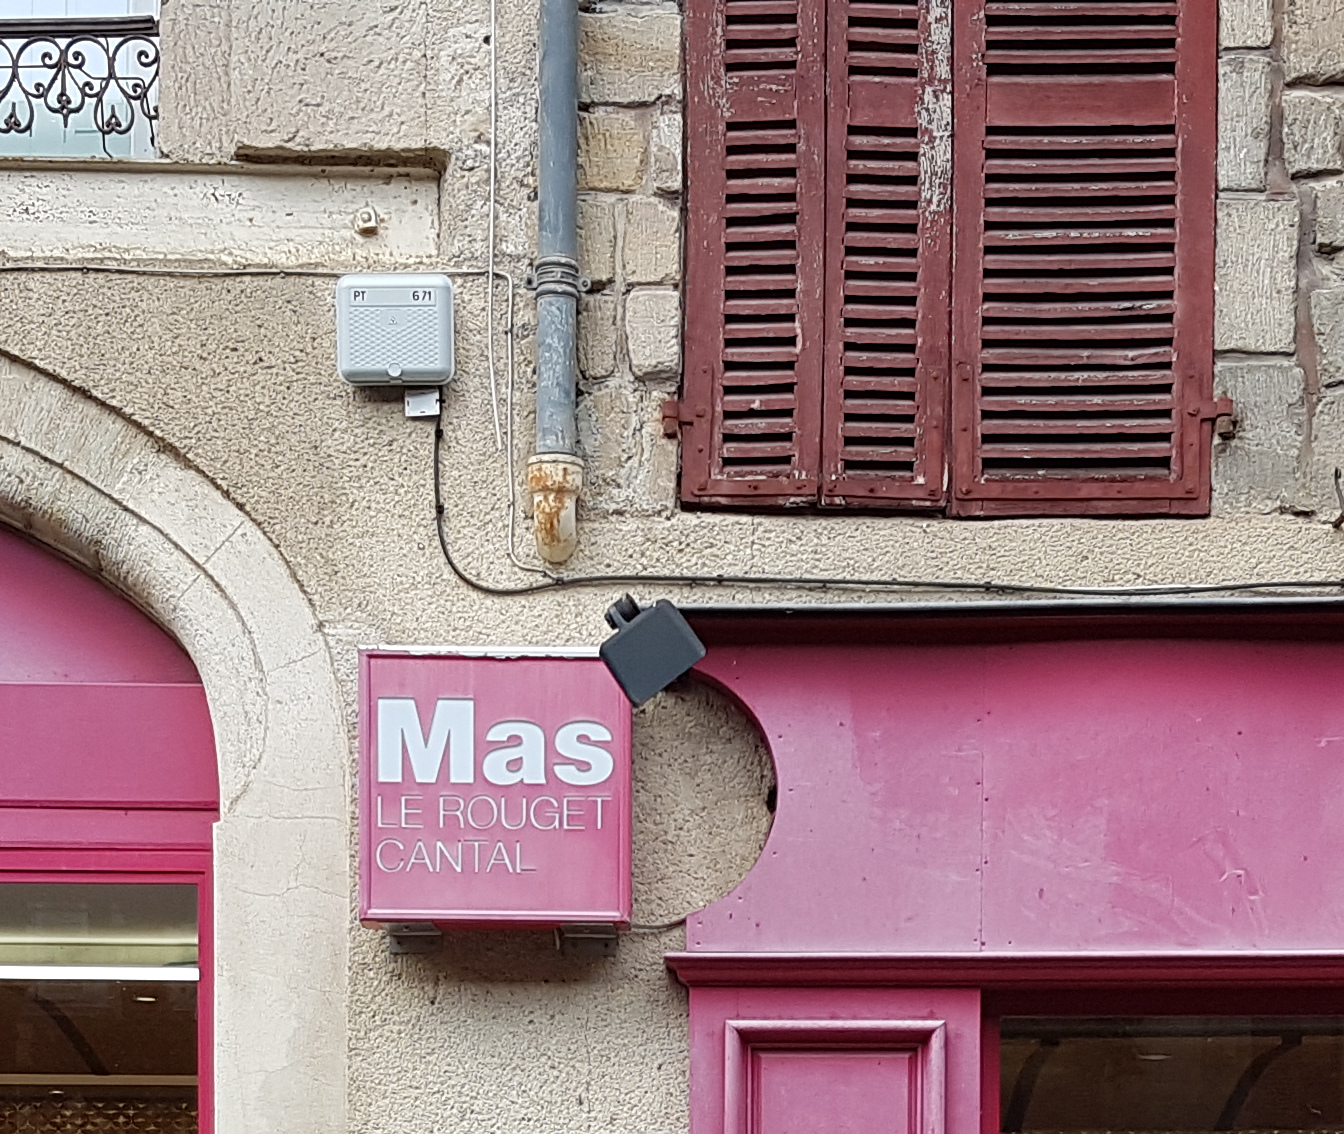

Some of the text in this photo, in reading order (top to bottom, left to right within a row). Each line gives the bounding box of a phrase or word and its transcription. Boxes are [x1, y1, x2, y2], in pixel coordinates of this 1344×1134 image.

[353, 290, 367, 302] PT
[377, 697, 614, 786] Mas
[377, 794, 612, 830] LE ROUGET
[375, 838, 537, 874] CANTAL
